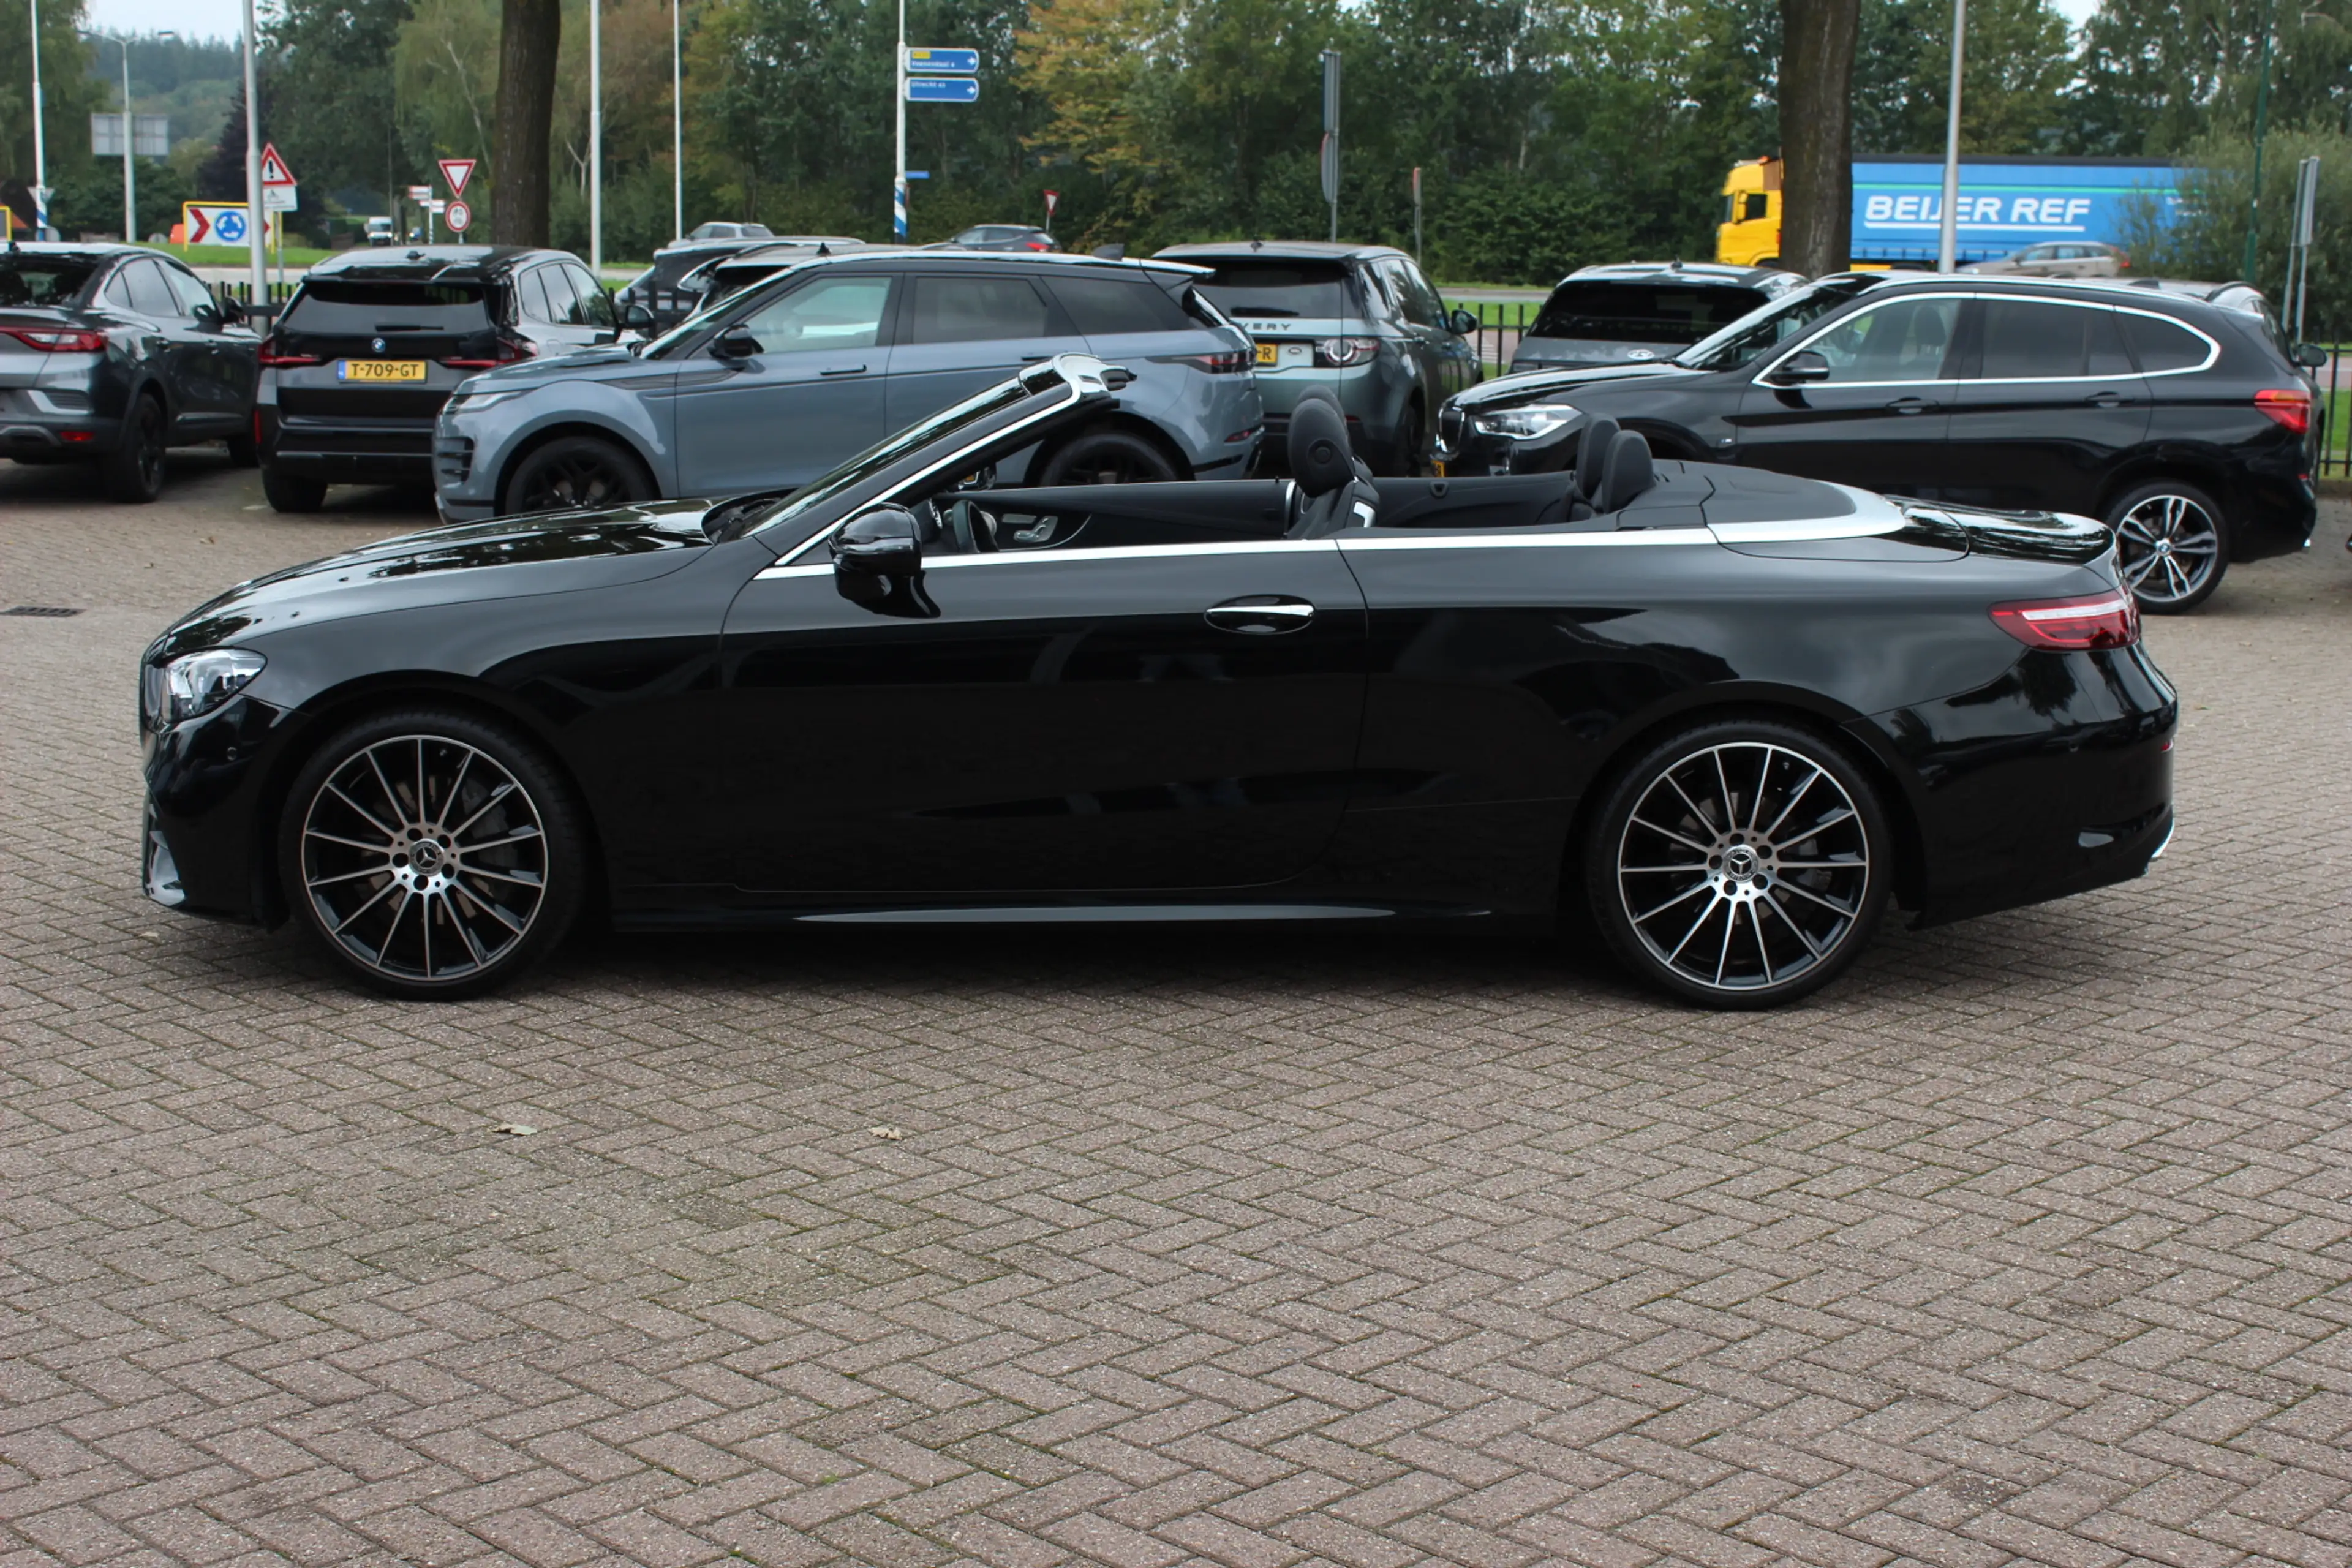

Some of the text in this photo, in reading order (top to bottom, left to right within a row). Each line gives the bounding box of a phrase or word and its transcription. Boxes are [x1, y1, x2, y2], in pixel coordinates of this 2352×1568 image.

[1864, 195, 2091, 224] BEIJER REF
[351, 363, 419, 377] T-709-GT
